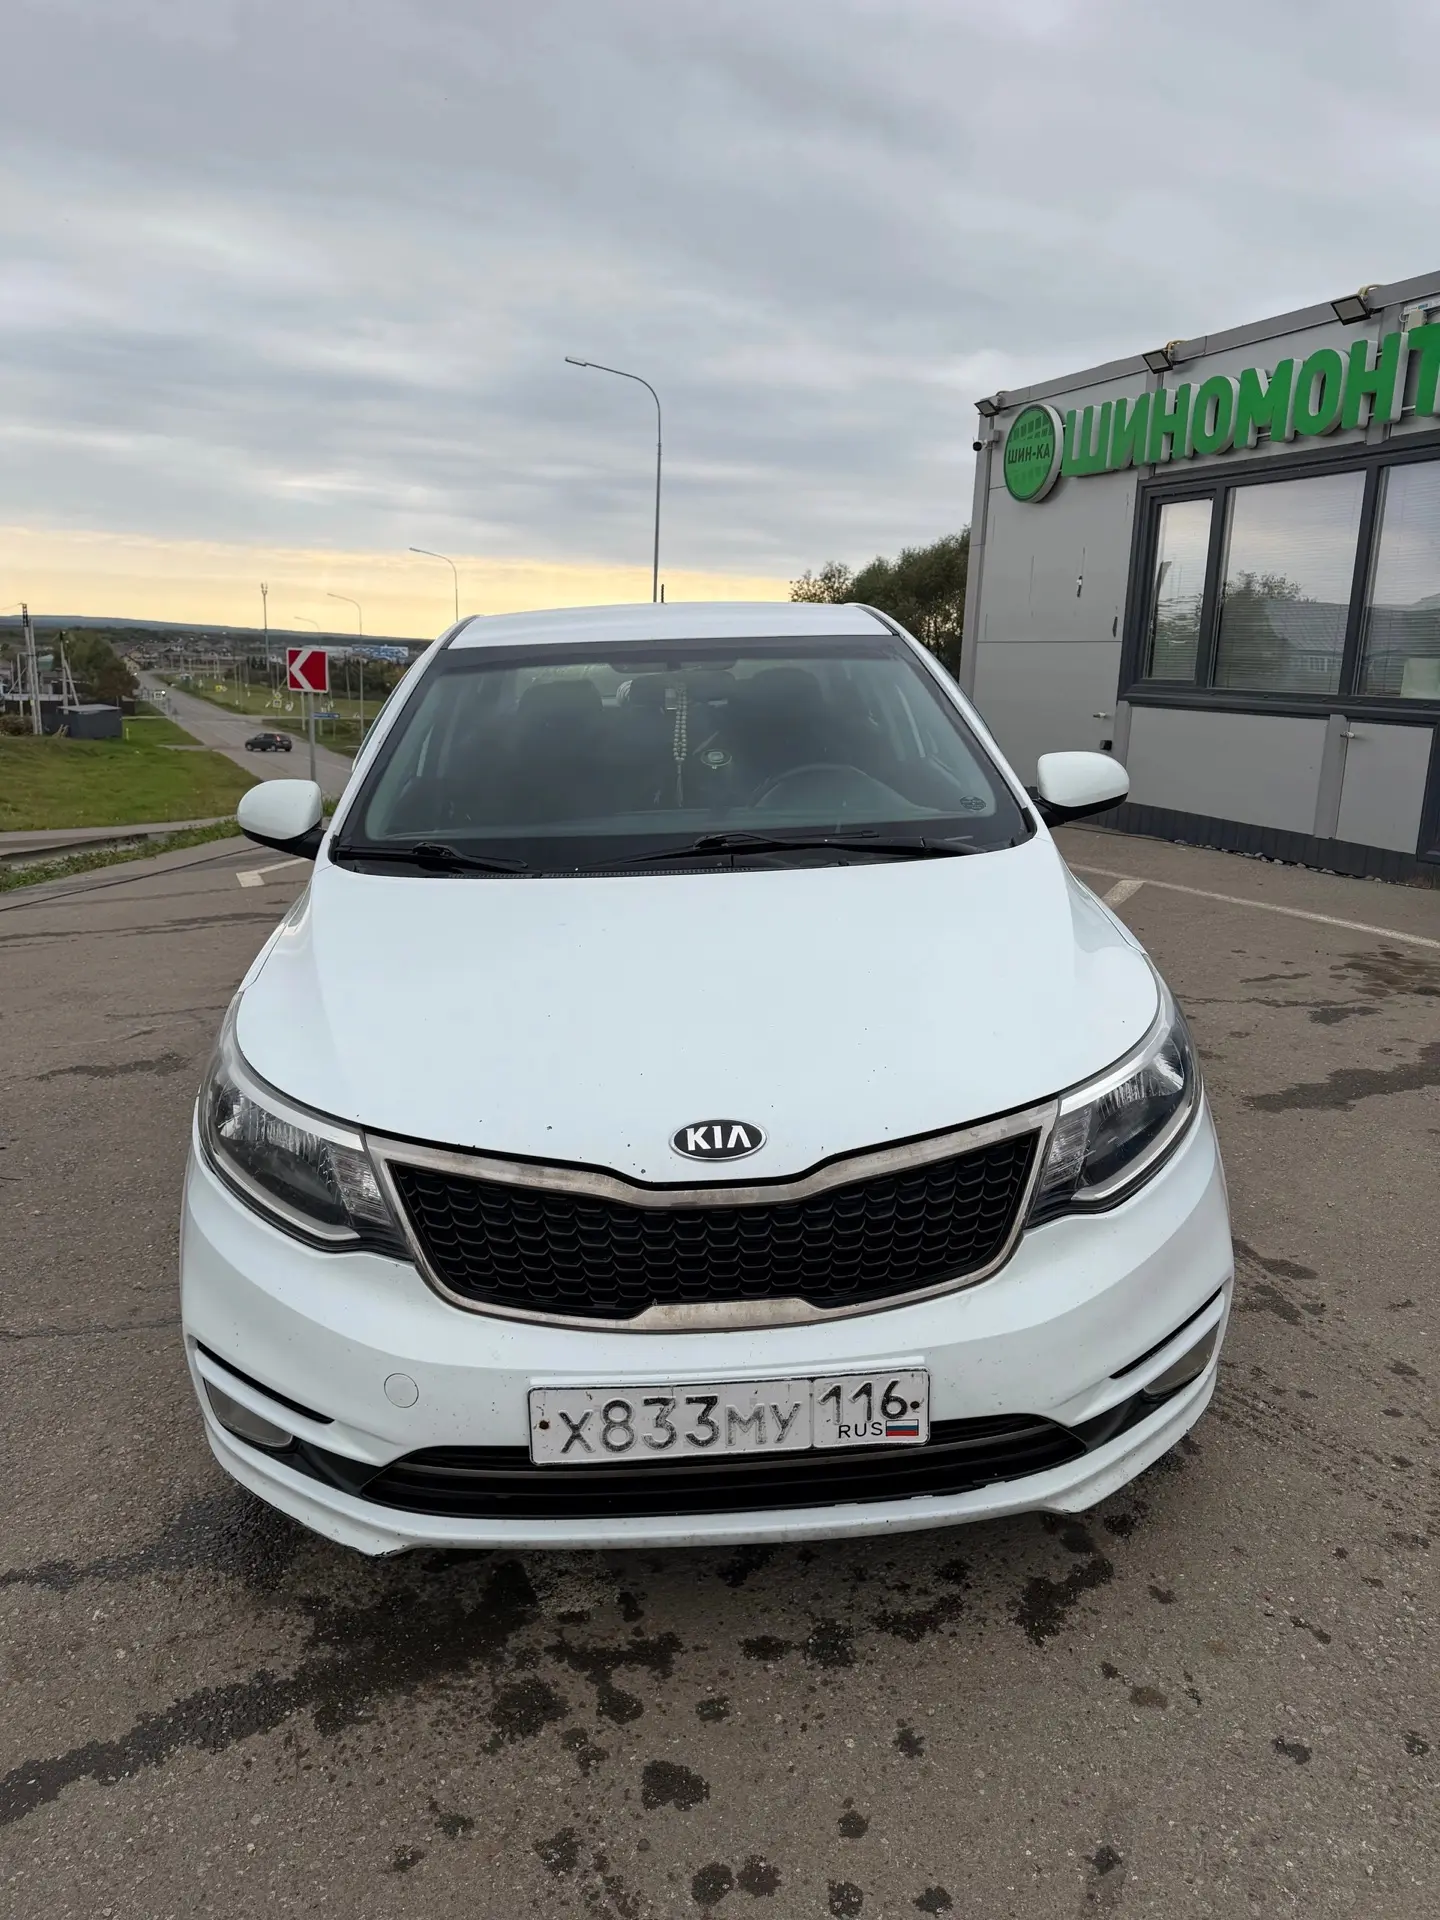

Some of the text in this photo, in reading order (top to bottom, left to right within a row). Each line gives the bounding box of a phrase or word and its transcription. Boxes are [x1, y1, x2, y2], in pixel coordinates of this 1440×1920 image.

[1007, 442, 1050, 465] ШИН-КА
[685, 1125, 752, 1151] KIA
[819, 1379, 908, 1424] 116
[838, 1422, 883, 1439] RUS
